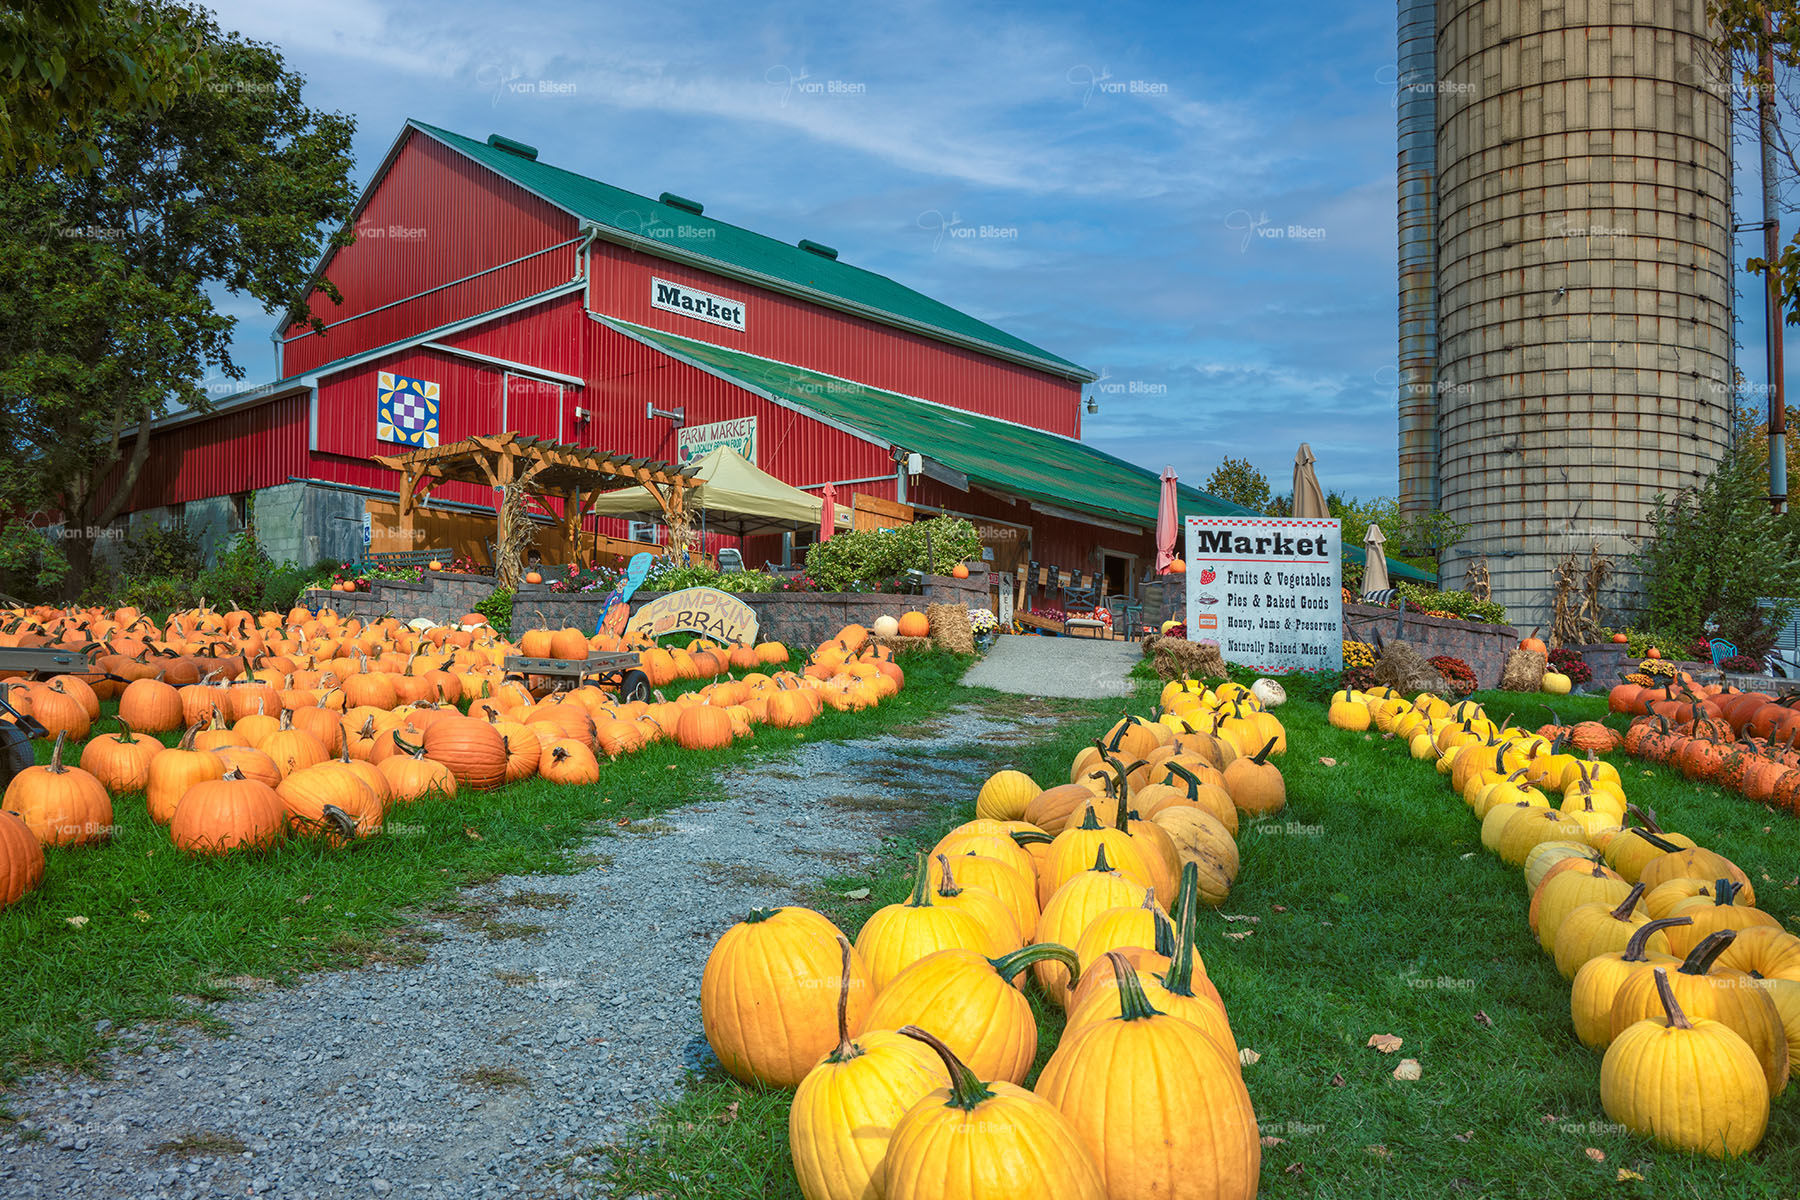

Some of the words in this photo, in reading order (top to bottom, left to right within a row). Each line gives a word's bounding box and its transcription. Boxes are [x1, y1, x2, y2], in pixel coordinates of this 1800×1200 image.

[657, 284, 741, 324] Market
[680, 427, 706, 445] FARM
[710, 418, 754, 441] MARKET
[694, 443, 712, 454] LOCALLY
[731, 438, 742, 448] FOOD
[1198, 530, 1328, 557] Market
[1227, 571, 1258, 585] Fruits
[1264, 571, 1272, 585] &
[1278, 572, 1331, 589] Vegetables
[1227, 593, 1247, 607] Pies
[1253, 594, 1261, 608] &
[1266, 594, 1296, 609] Baked
[1301, 596, 1329, 609] Goods
[650, 591, 752, 630] PUMPKIN
[1227, 616, 1255, 631] Honey,
[1259, 617, 1280, 630] Jams
[1284, 618, 1292, 630] &
[1295, 618, 1337, 632] Preserves
[1228, 640, 1265, 655] Naturally
[1268, 642, 1297, 655] Raised
[1301, 643, 1328, 656] Meats
